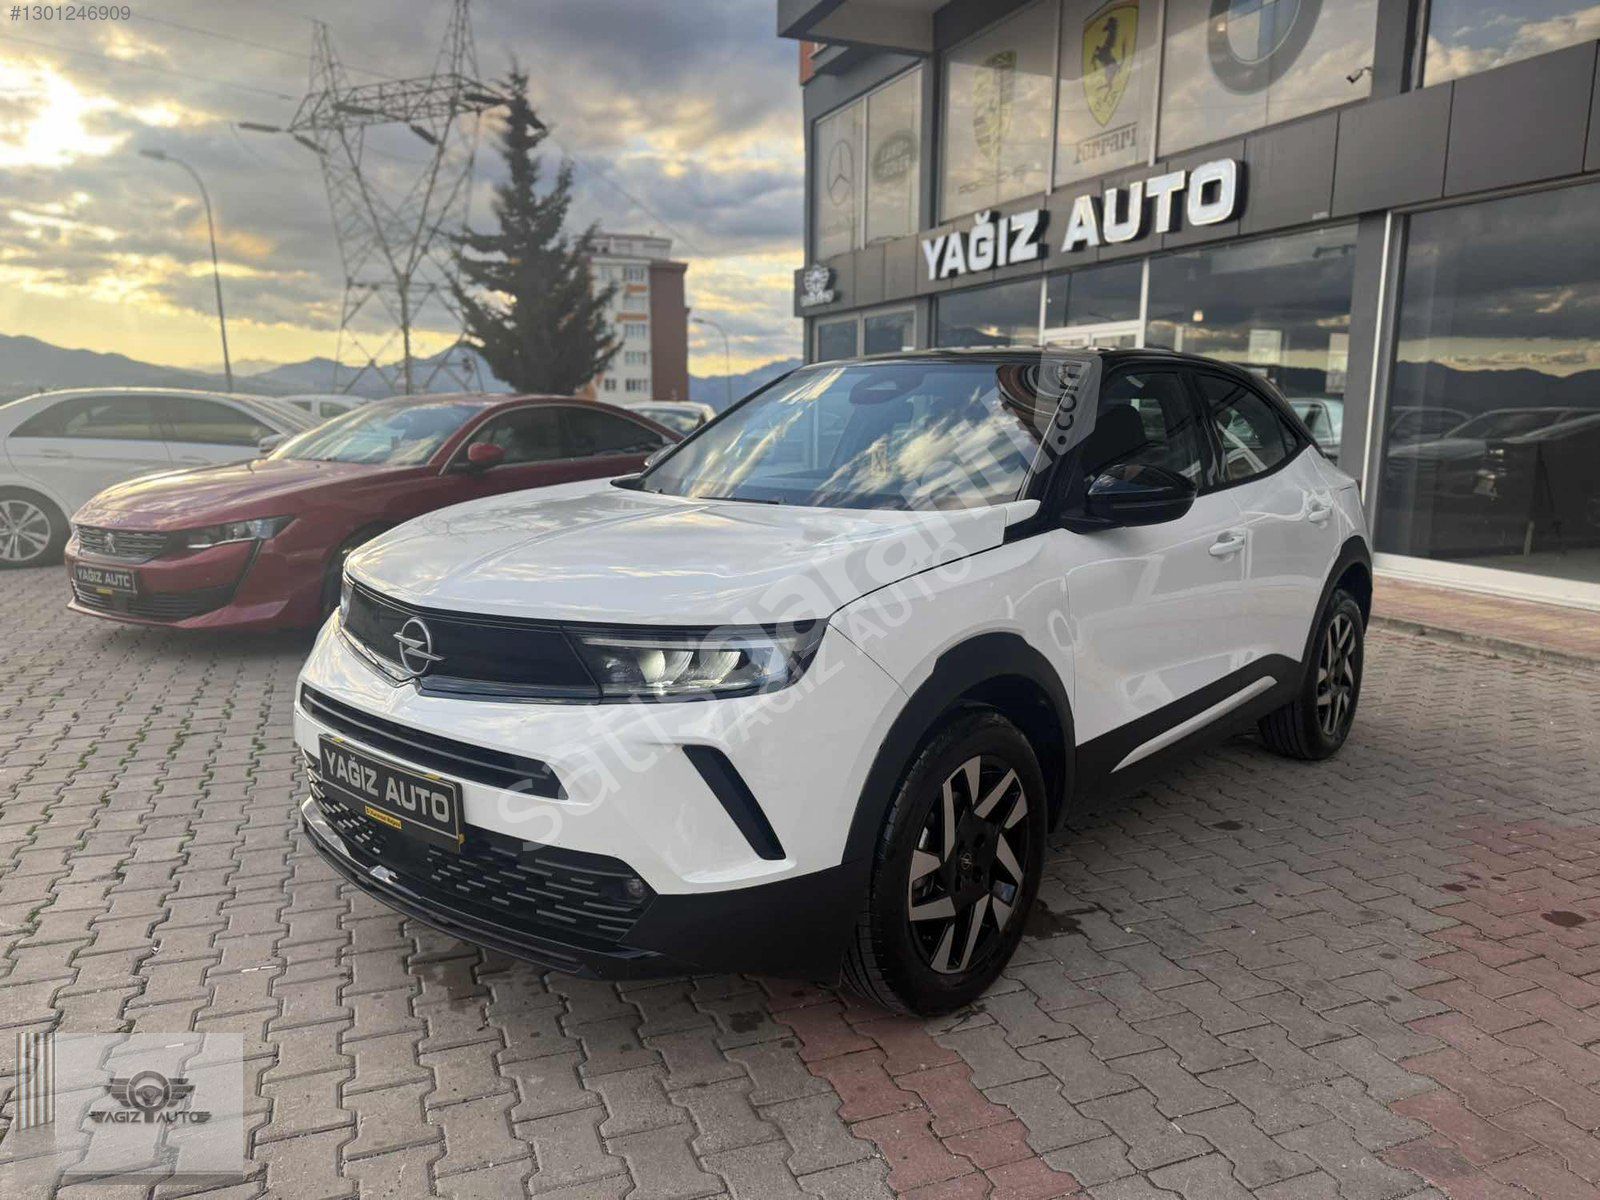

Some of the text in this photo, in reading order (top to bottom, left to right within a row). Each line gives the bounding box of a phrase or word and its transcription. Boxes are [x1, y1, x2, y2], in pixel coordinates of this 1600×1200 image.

[922, 158, 1237, 281] YAĞIZ AUTO
[324, 748, 379, 797] YAĞIZ
[386, 776, 450, 823] AUTO
